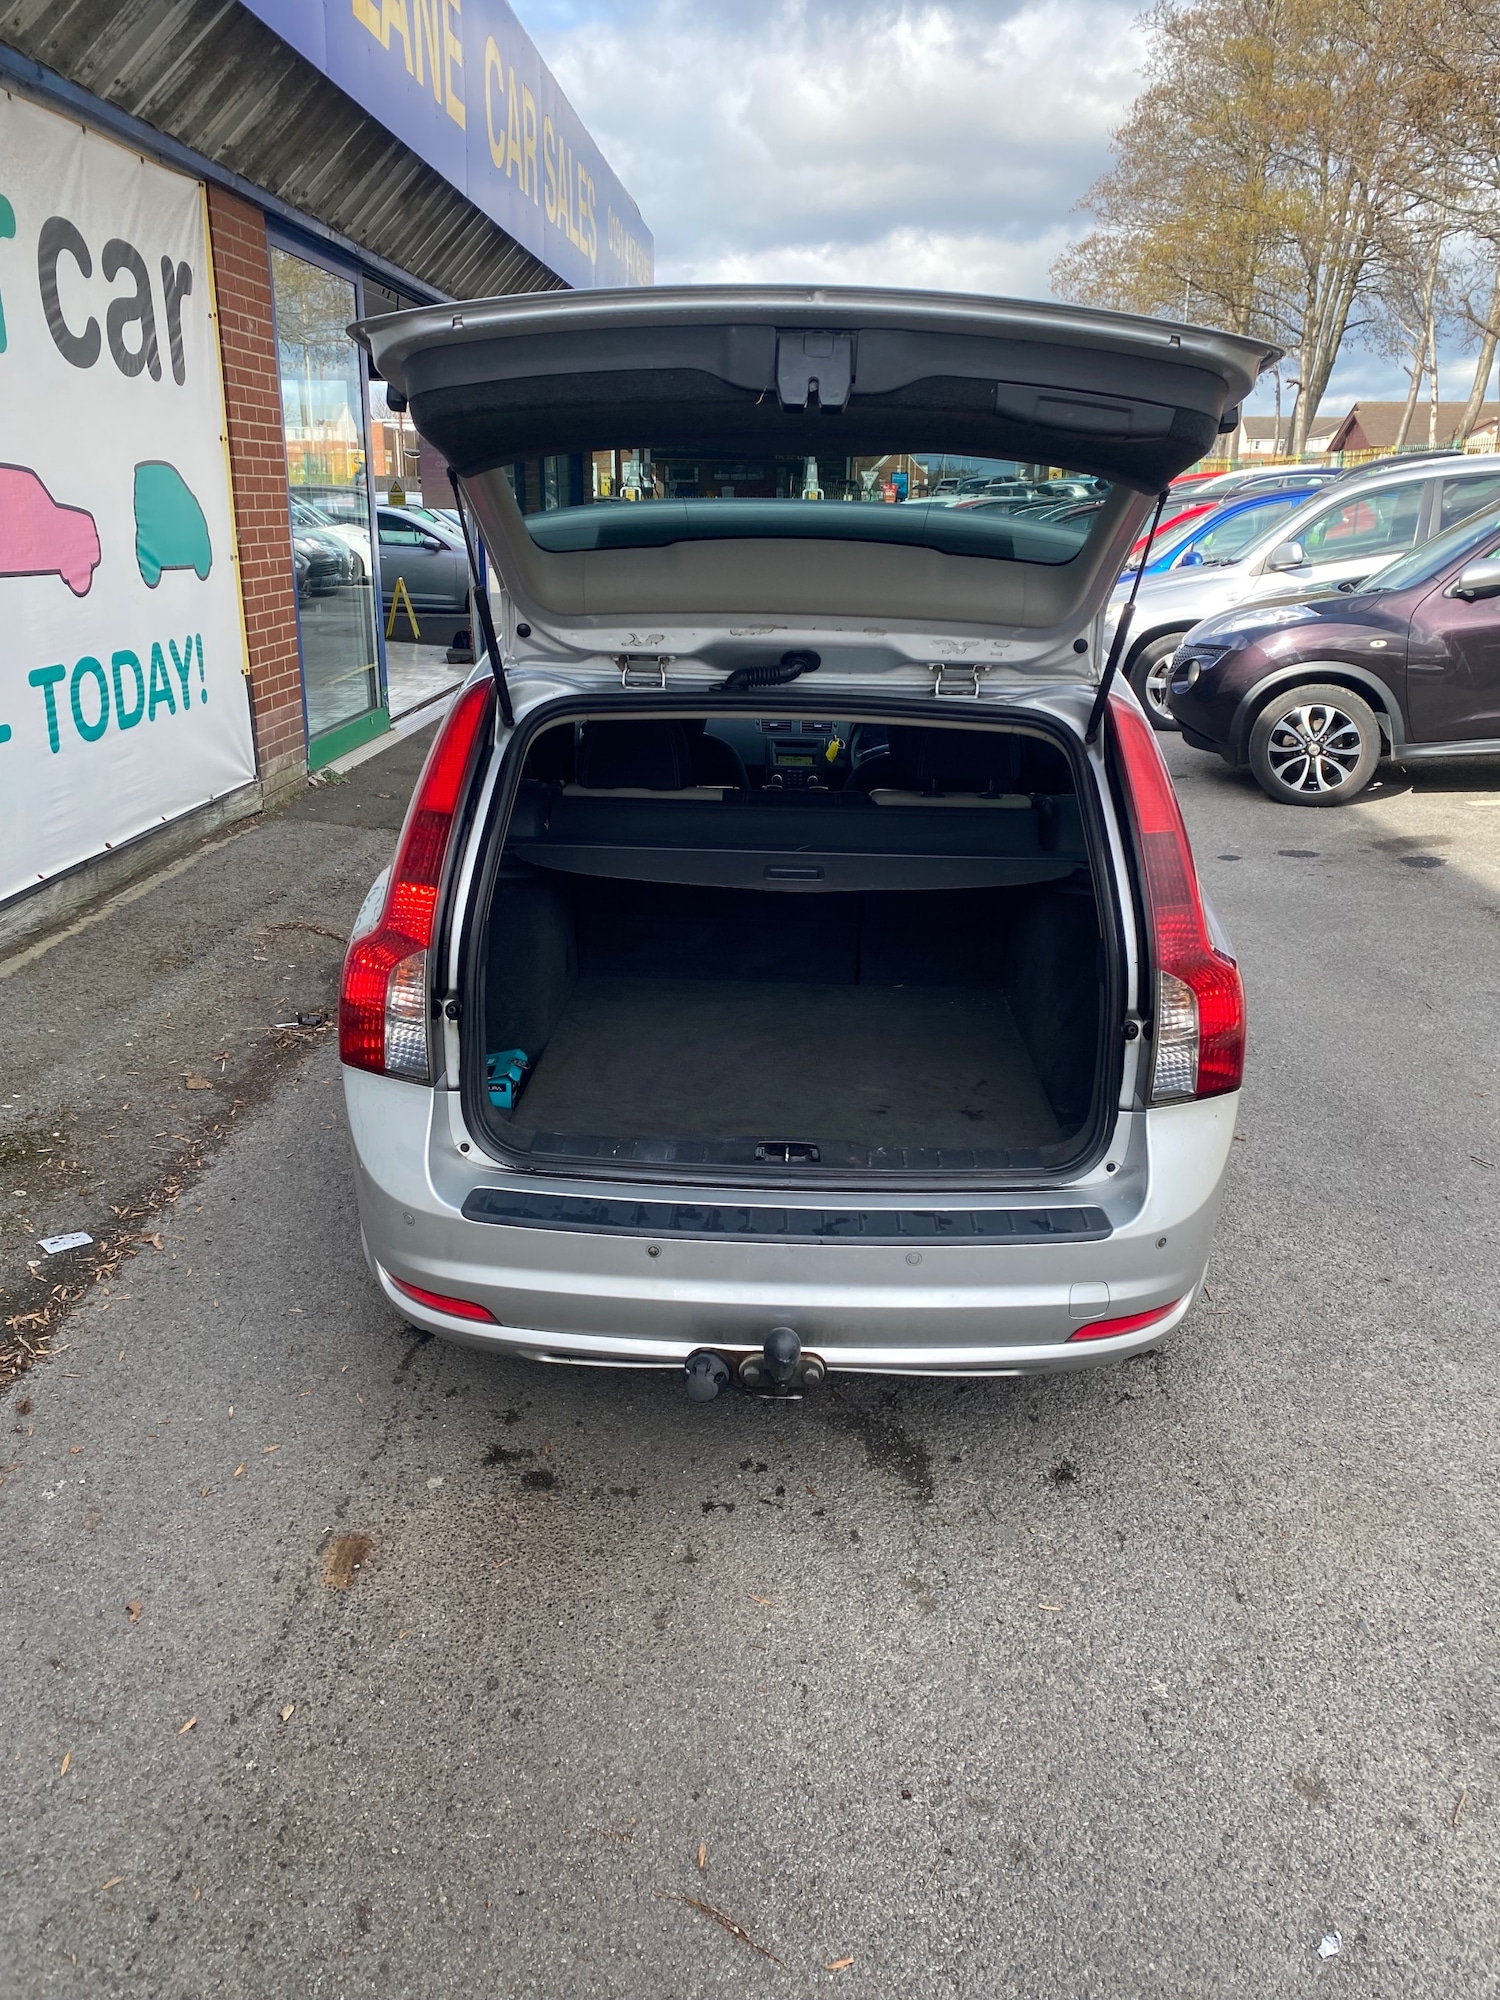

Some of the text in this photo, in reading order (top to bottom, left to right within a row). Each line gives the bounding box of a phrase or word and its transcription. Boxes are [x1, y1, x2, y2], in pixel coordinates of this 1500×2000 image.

[352, 0, 597, 266] NE CAR SALES
[38, 216, 193, 386] car
[28, 633, 208, 754] TODAY!
